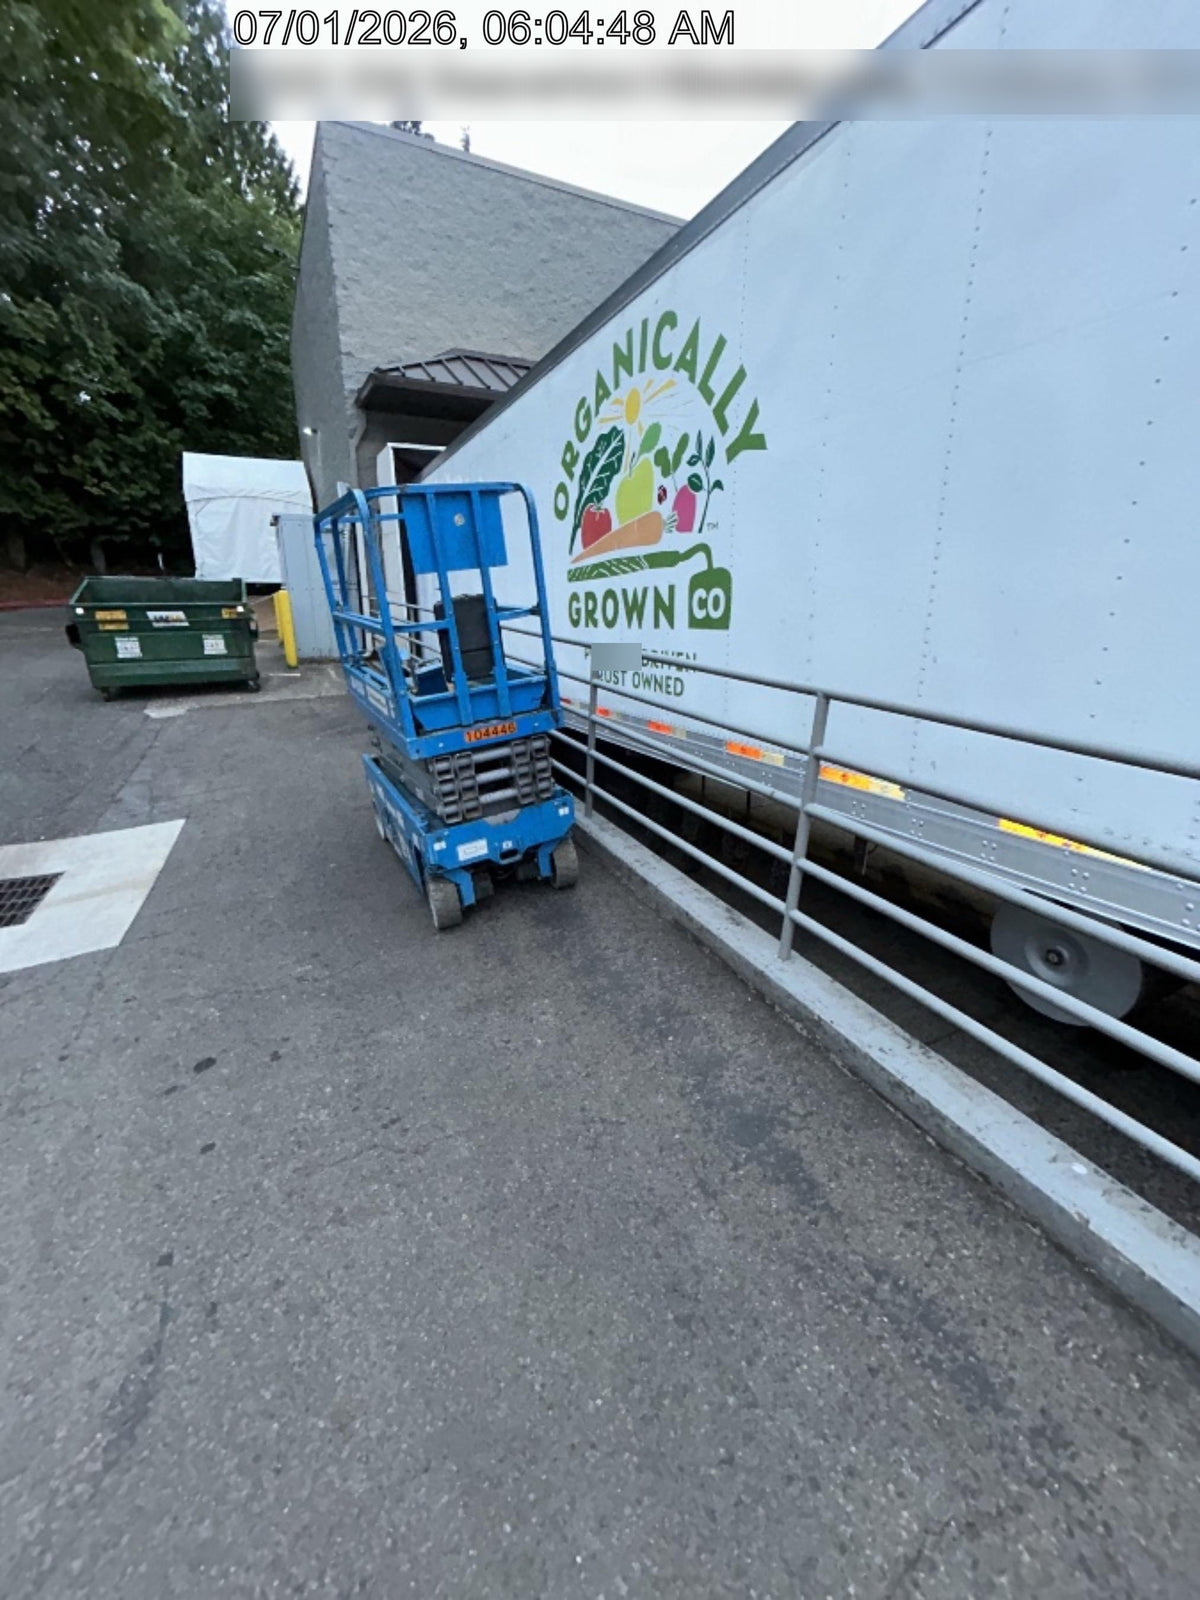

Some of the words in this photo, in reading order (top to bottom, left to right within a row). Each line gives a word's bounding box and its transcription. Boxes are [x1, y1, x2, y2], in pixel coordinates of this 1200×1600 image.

[554, 311, 767, 521] ORGANICALLY
[569, 585, 674, 628] GROWN
[693, 587, 726, 619] CO
[632, 671, 684, 696] OWNED
